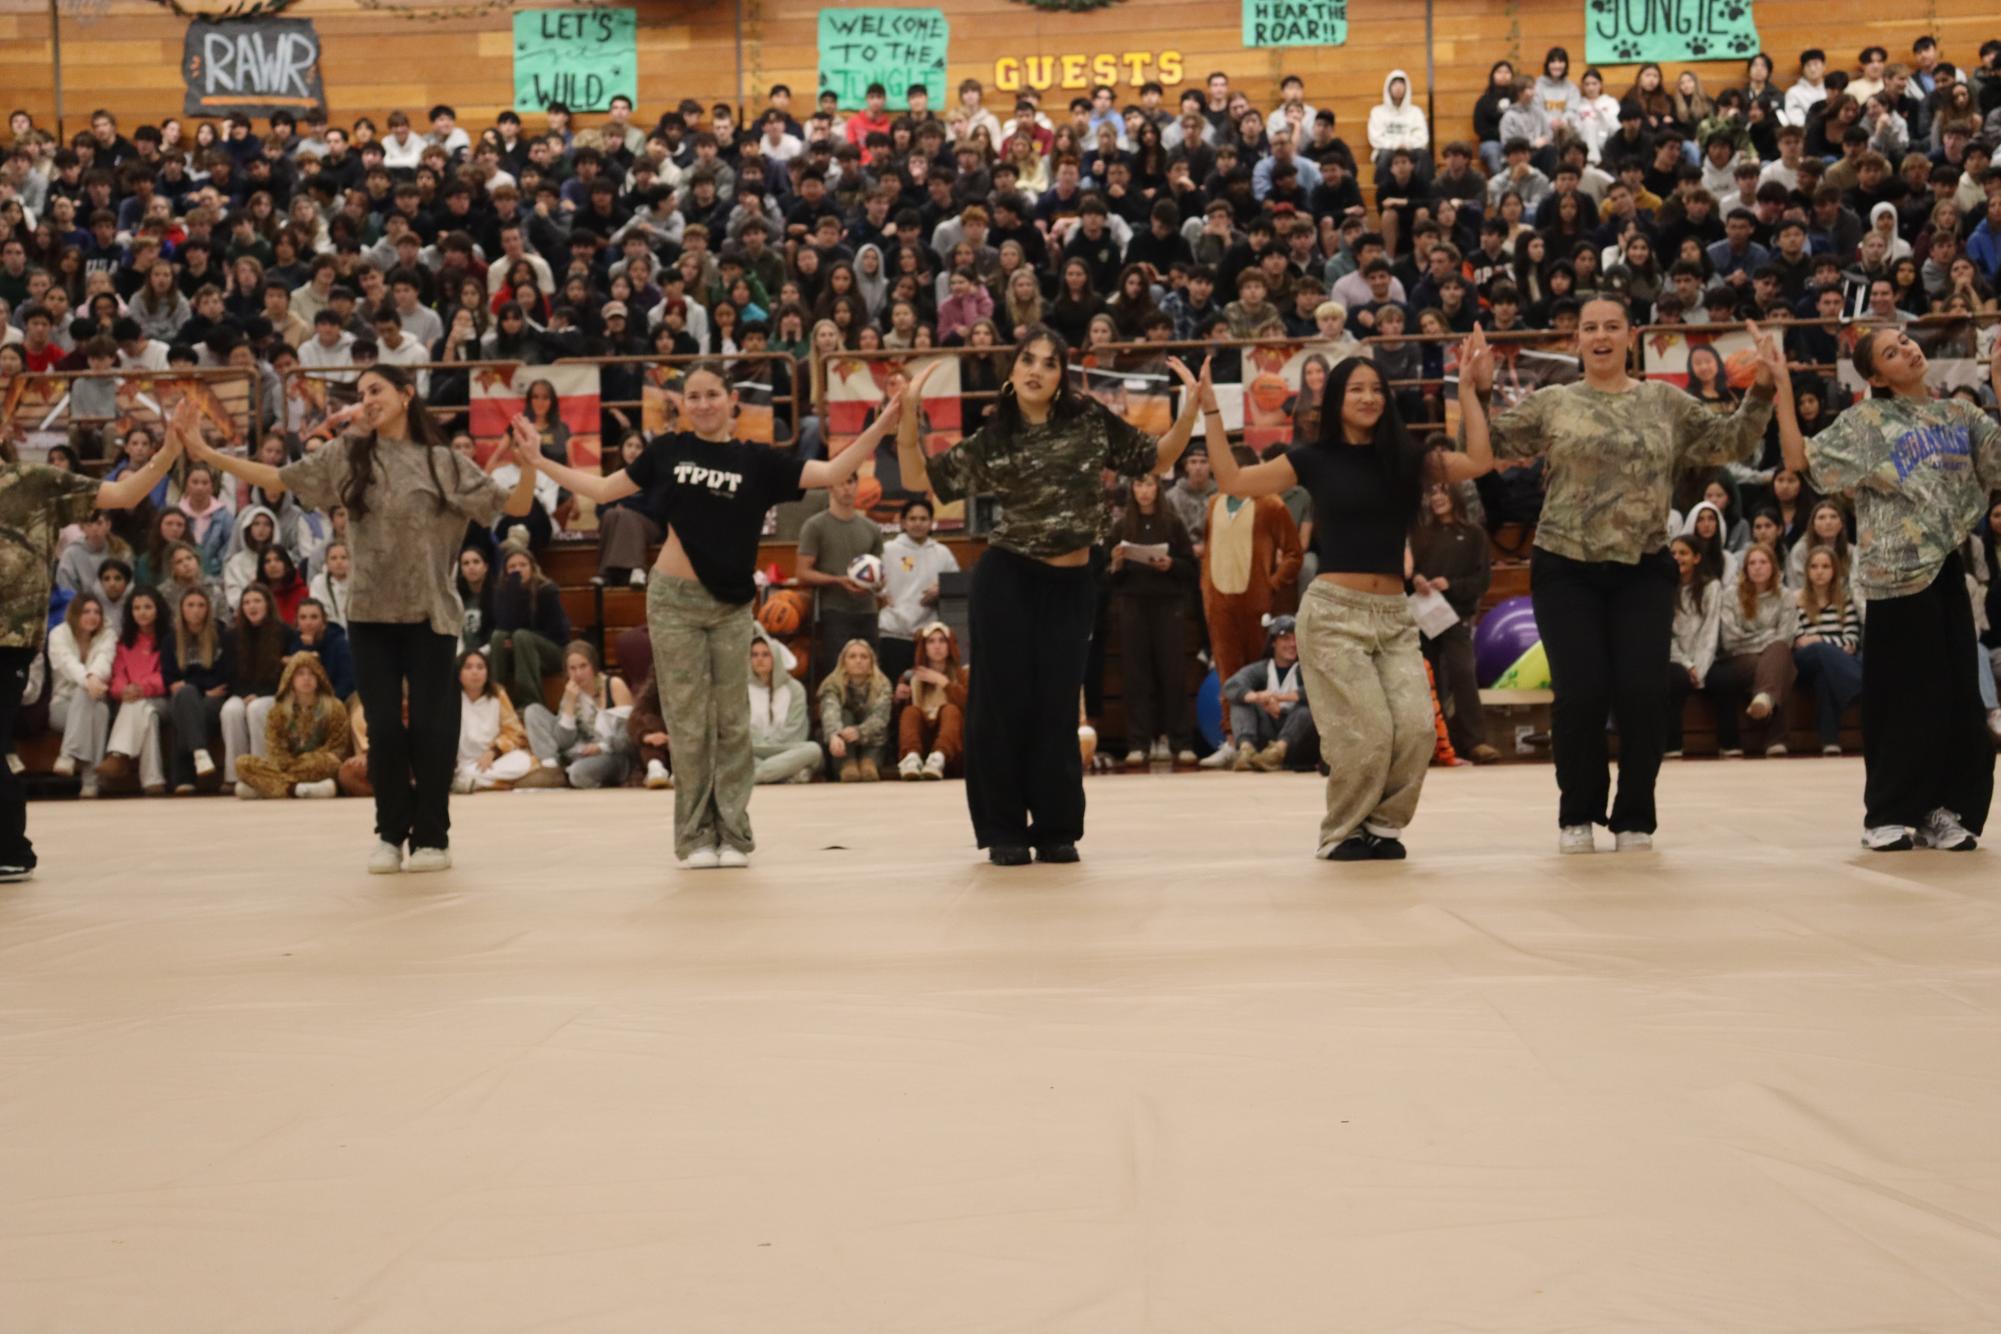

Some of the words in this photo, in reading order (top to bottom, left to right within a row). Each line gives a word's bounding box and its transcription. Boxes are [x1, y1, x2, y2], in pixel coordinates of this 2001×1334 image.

[1255, 3, 1308, 19] HEAR
[1312, 4, 1346, 19] THE
[541, 11, 612, 42] LET'S
[828, 15, 943, 41] WELCOME
[1255, 20, 1336, 46] ROAR!!
[204, 31, 317, 97] RAWR
[829, 43, 878, 62] TO
[884, 42, 933, 64] THE
[995, 50, 1183, 91] GUESTS
[533, 73, 604, 108] WILD
[674, 465, 742, 493] TPDT
